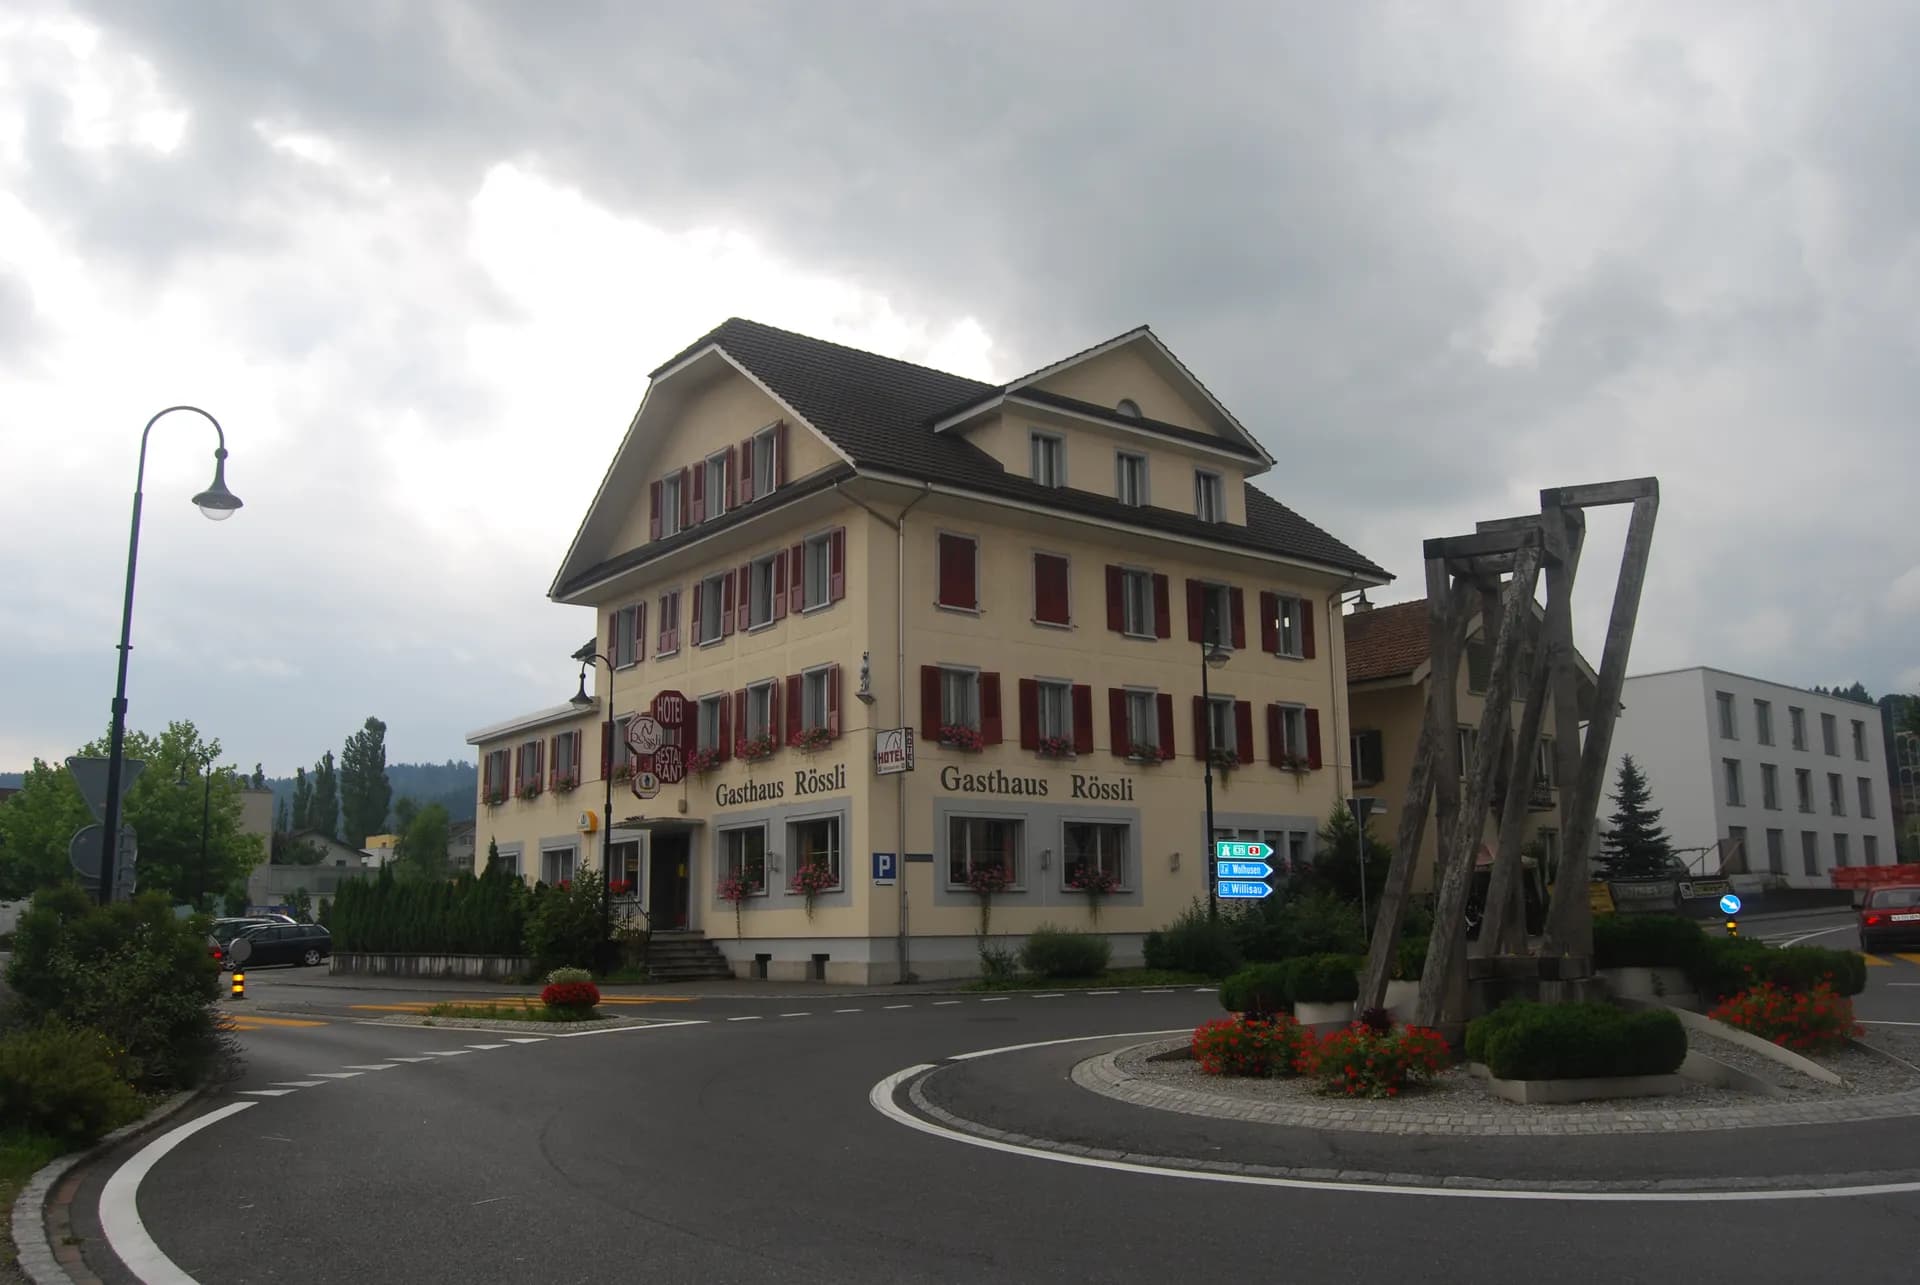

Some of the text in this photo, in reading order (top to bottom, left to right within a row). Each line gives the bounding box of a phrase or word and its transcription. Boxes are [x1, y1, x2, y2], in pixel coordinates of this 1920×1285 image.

[878, 749, 905, 765] HOTEL
[716, 764, 846, 807] Gasthaus Rössli
[940, 765, 1135, 801] Gasthaus Rössli
[878, 855, 891, 877] P
[1231, 883, 1262, 894] Willisau
